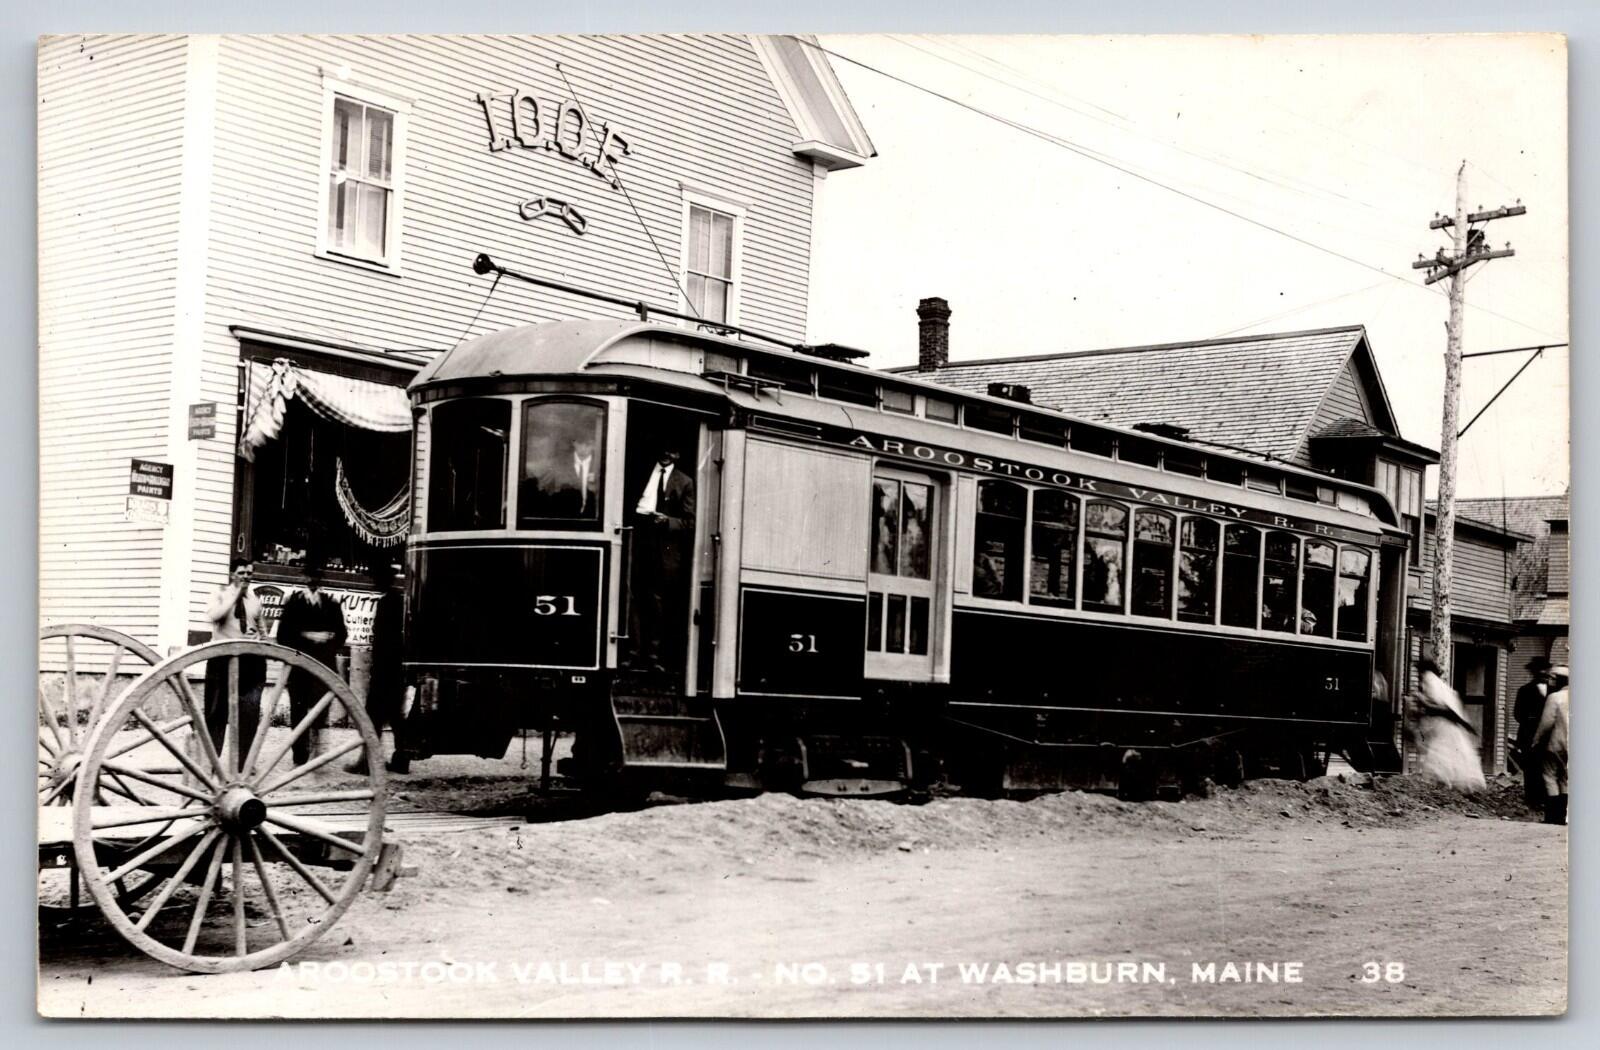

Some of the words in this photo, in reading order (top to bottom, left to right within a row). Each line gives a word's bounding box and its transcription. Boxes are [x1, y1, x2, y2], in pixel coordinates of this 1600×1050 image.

[849, 434, 1098, 491] AROOSTOOK
[1129, 487, 1248, 518] VALLEY
[1274, 516, 1295, 528] R.
[1315, 524, 1334, 536] R.
[340, 594, 380, 612] KUTT
[533, 595, 582, 616] 51
[346, 614, 374, 626] Cutler
[788, 634, 819, 653] 51
[1325, 677, 1340, 690] 51
